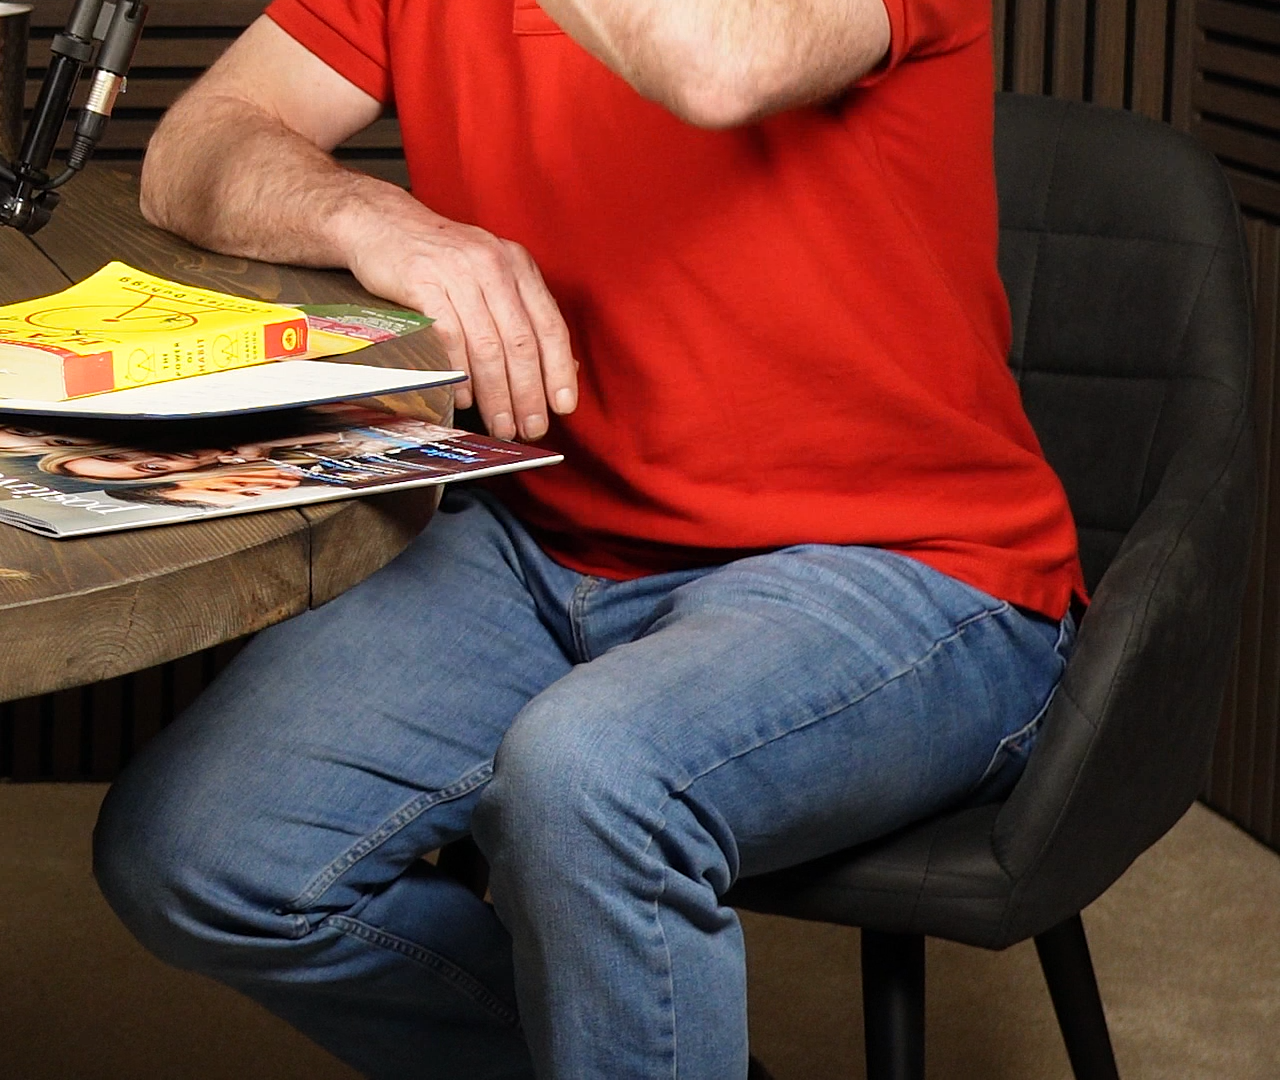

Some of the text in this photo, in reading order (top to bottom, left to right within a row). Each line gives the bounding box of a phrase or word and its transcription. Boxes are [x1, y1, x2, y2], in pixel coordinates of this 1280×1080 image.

[118, 276, 187, 300] Duhigg
[187, 351, 193, 364] OF
[197, 338, 205, 372] HABIT
